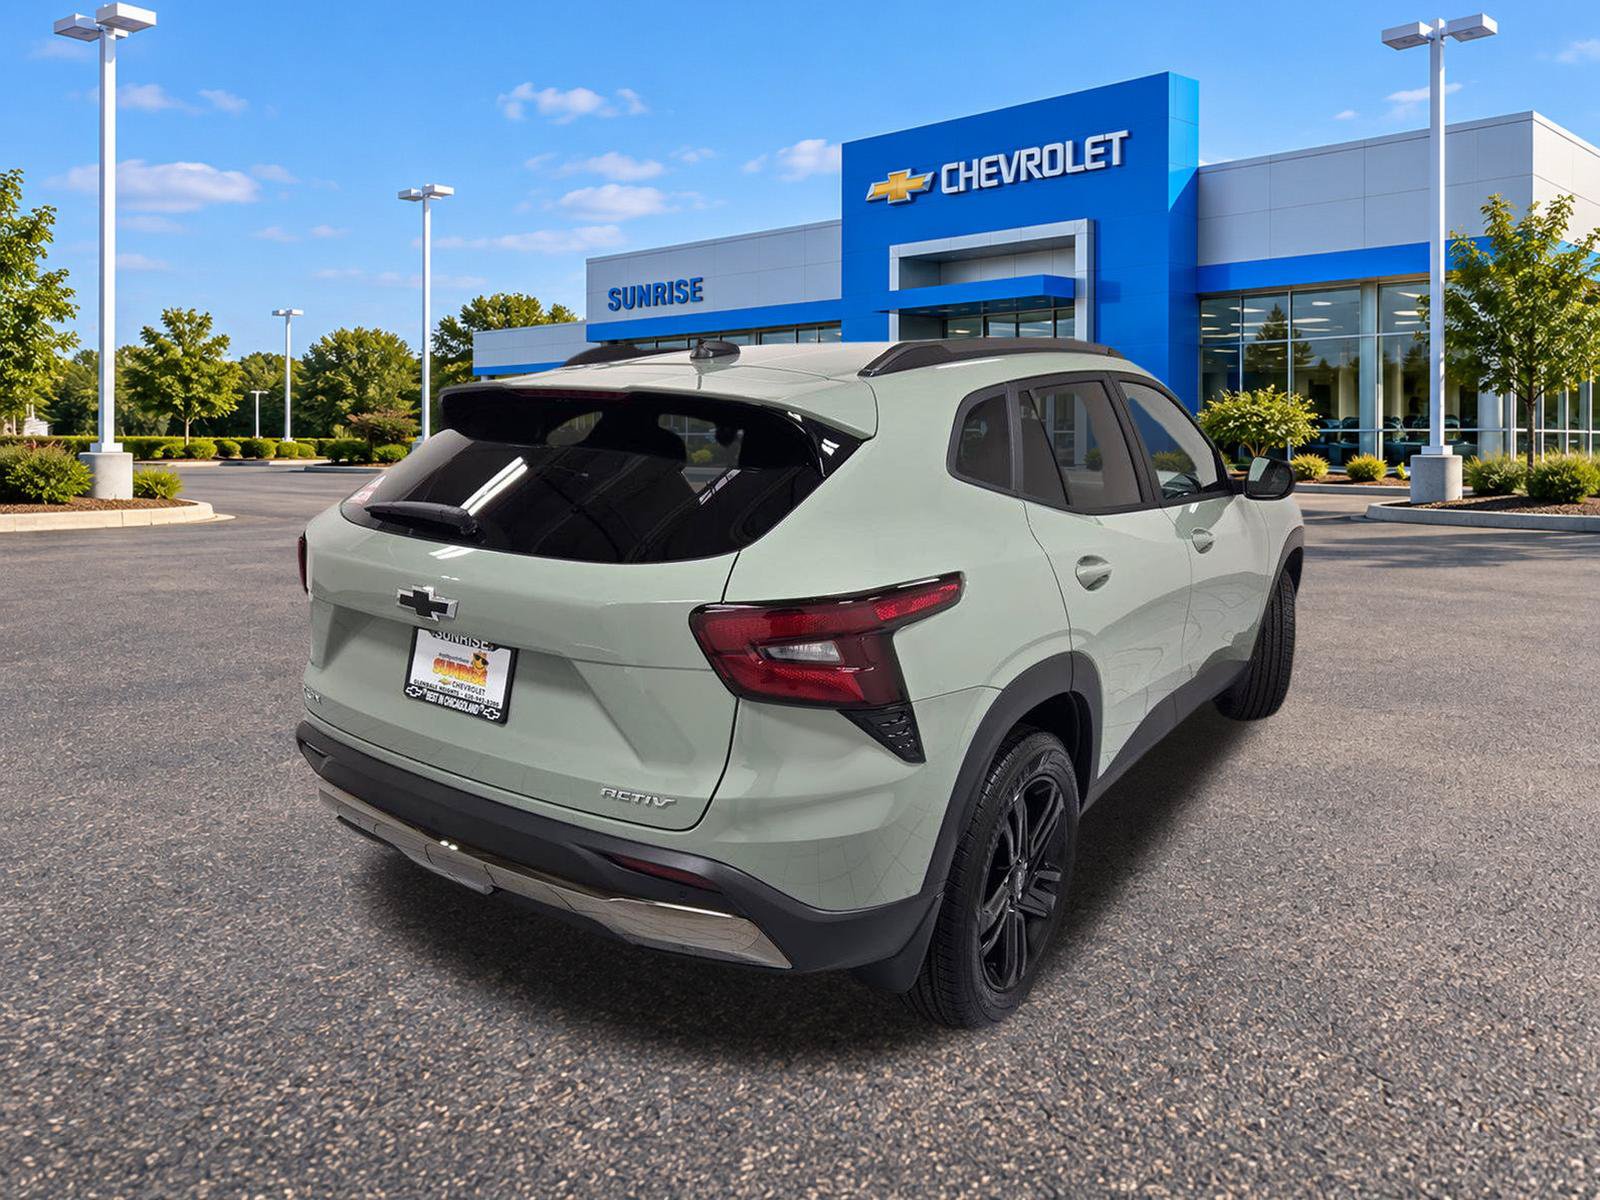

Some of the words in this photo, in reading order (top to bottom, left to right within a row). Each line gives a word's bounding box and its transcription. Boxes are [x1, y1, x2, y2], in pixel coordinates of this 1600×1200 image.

[941, 130, 1129, 194] CHEVROLET
[608, 277, 704, 311] SUNRISE
[452, 681, 486, 695] CHEVROLET
[438, 694, 444, 705] IN
[601, 787, 676, 807] ACTIV
